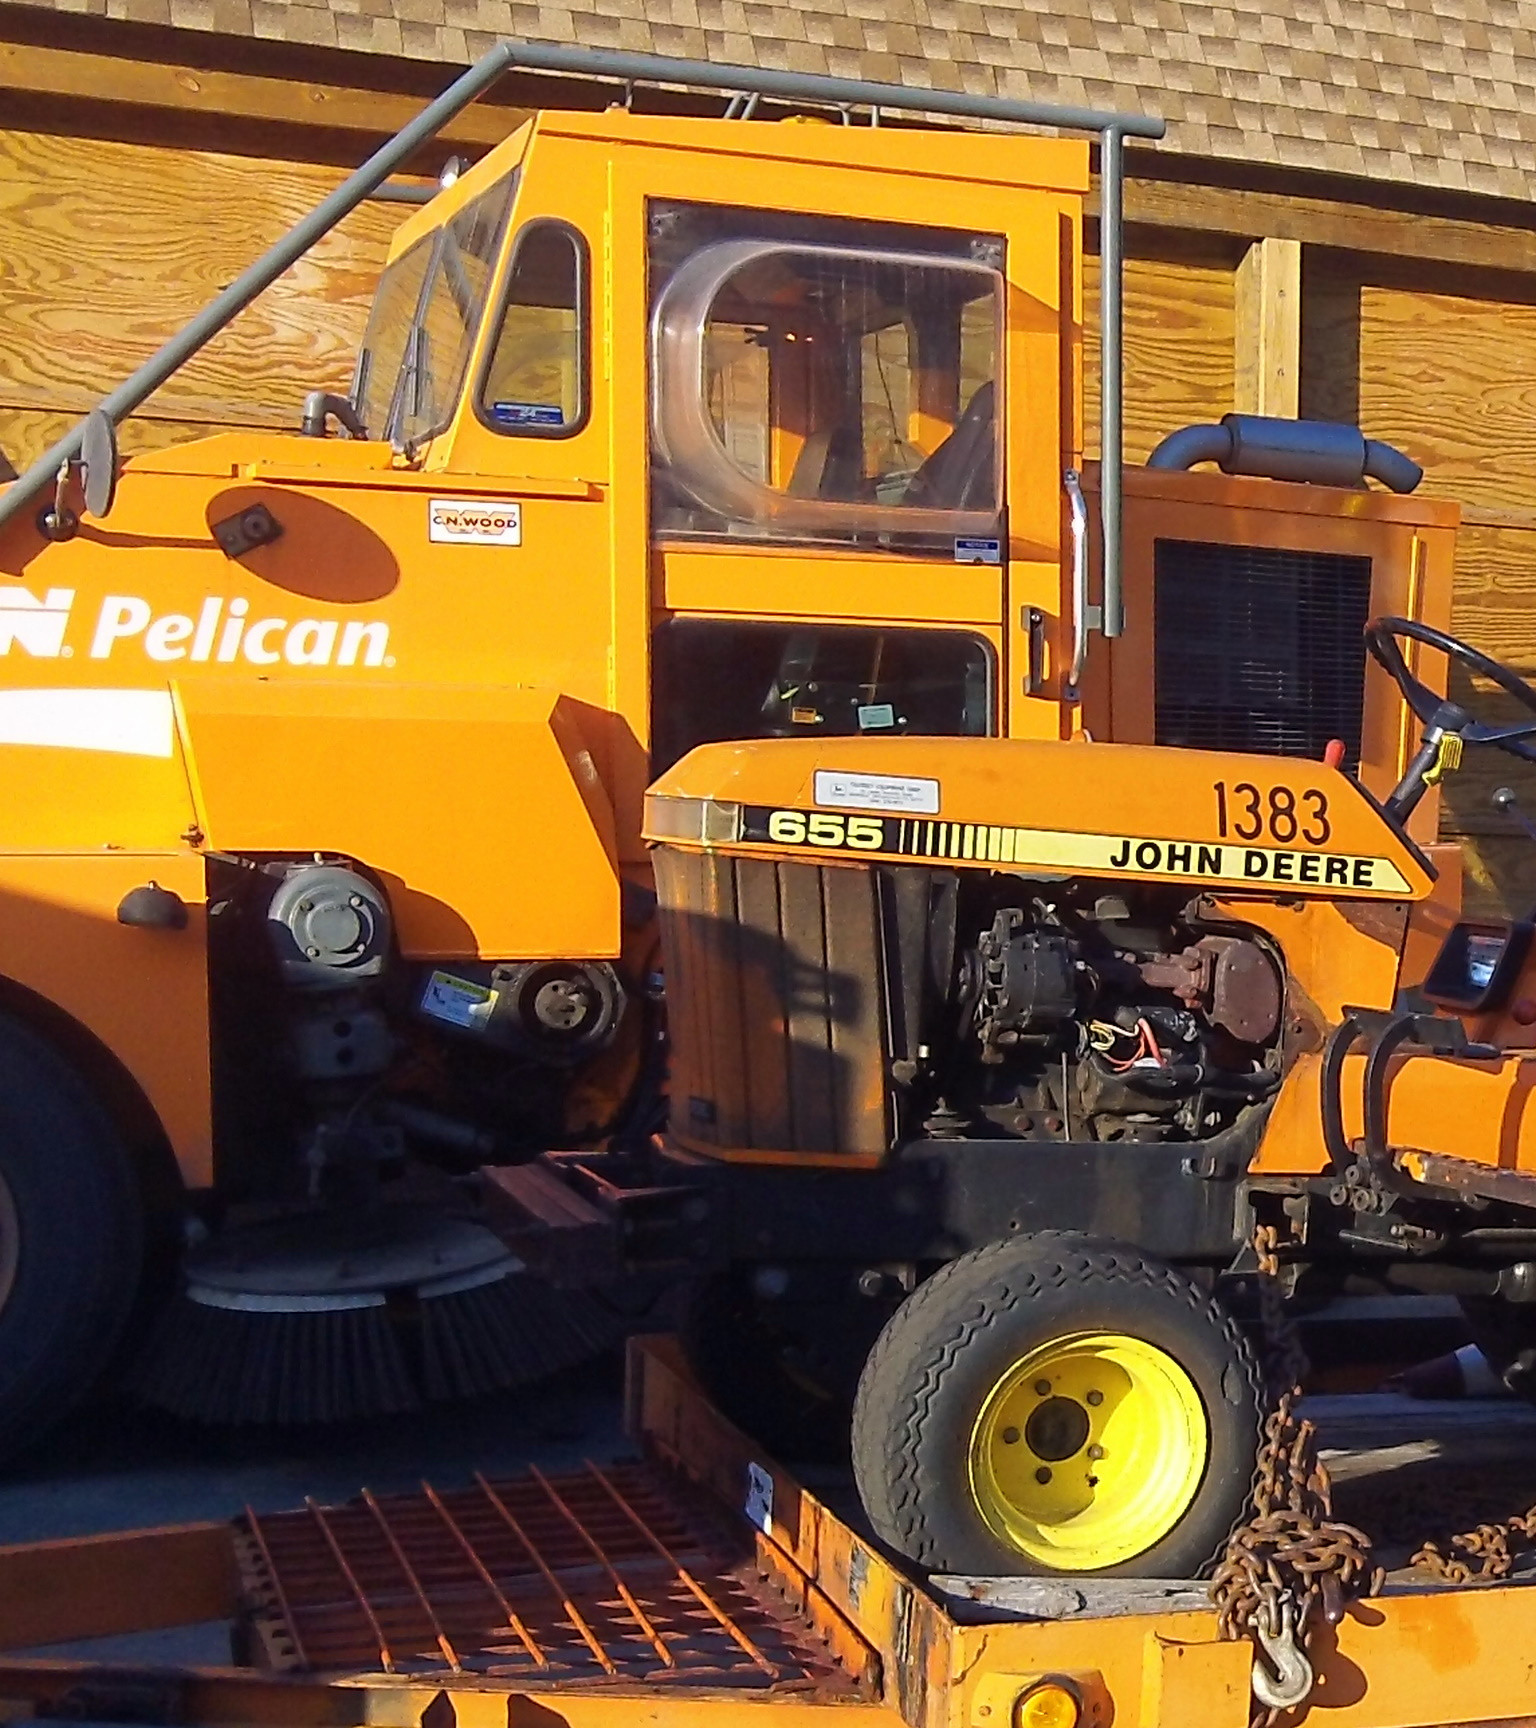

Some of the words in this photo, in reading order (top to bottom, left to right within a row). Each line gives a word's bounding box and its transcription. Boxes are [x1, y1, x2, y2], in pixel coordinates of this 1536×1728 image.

[90, 595, 391, 668] Pelican
[768, 810, 883, 850] 655
[1213, 781, 1331, 846] 1383
[1109, 840, 1223, 875] JOHN
[1243, 850, 1374, 888] DEERE
